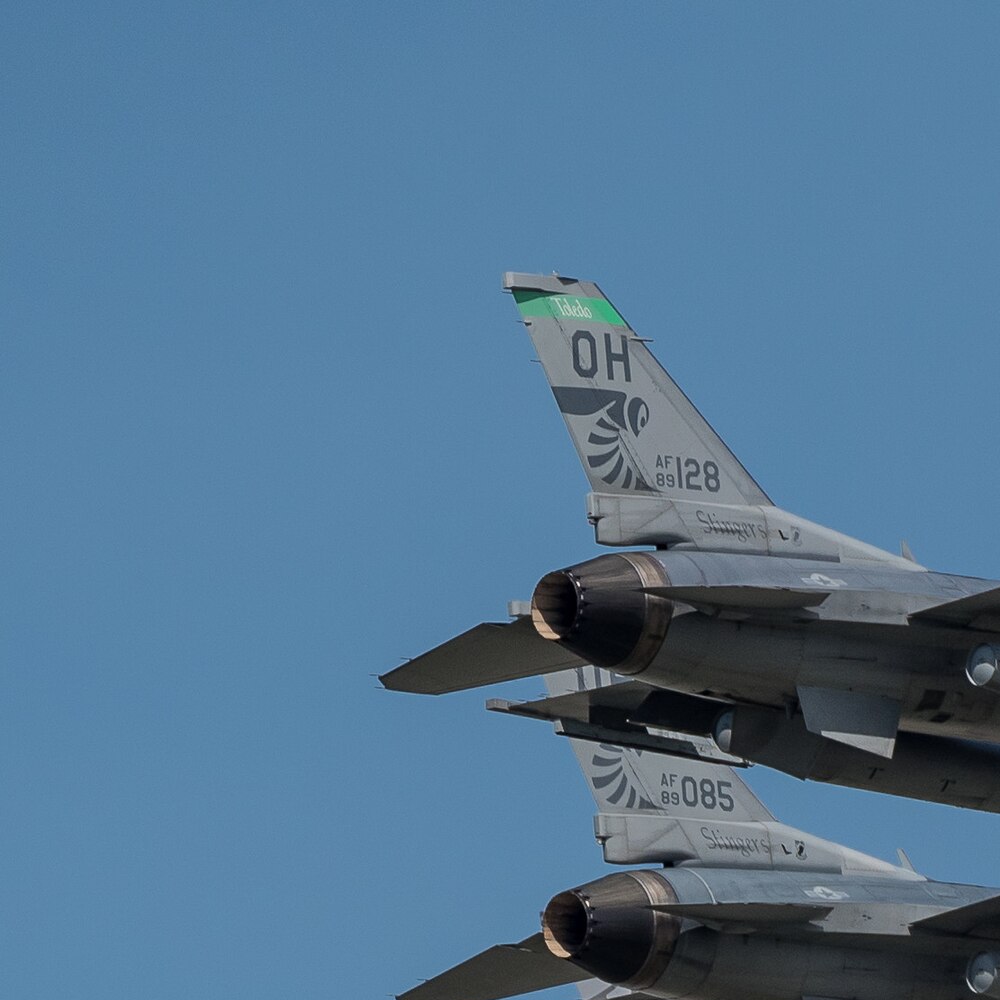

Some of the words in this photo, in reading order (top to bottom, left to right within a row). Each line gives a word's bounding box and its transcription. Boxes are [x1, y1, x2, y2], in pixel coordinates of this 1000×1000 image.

[550, 297, 592, 319] Toledo
[571, 330, 632, 383] OH
[655, 454, 675, 470] AF
[677, 457, 721, 492] 128
[656, 474, 675, 488] 89
[696, 510, 768, 540] Stingers
[660, 773, 678, 787] AF
[661, 791, 680, 806] 89
[680, 776, 735, 812] 085
[700, 826, 770, 856] Stingers
